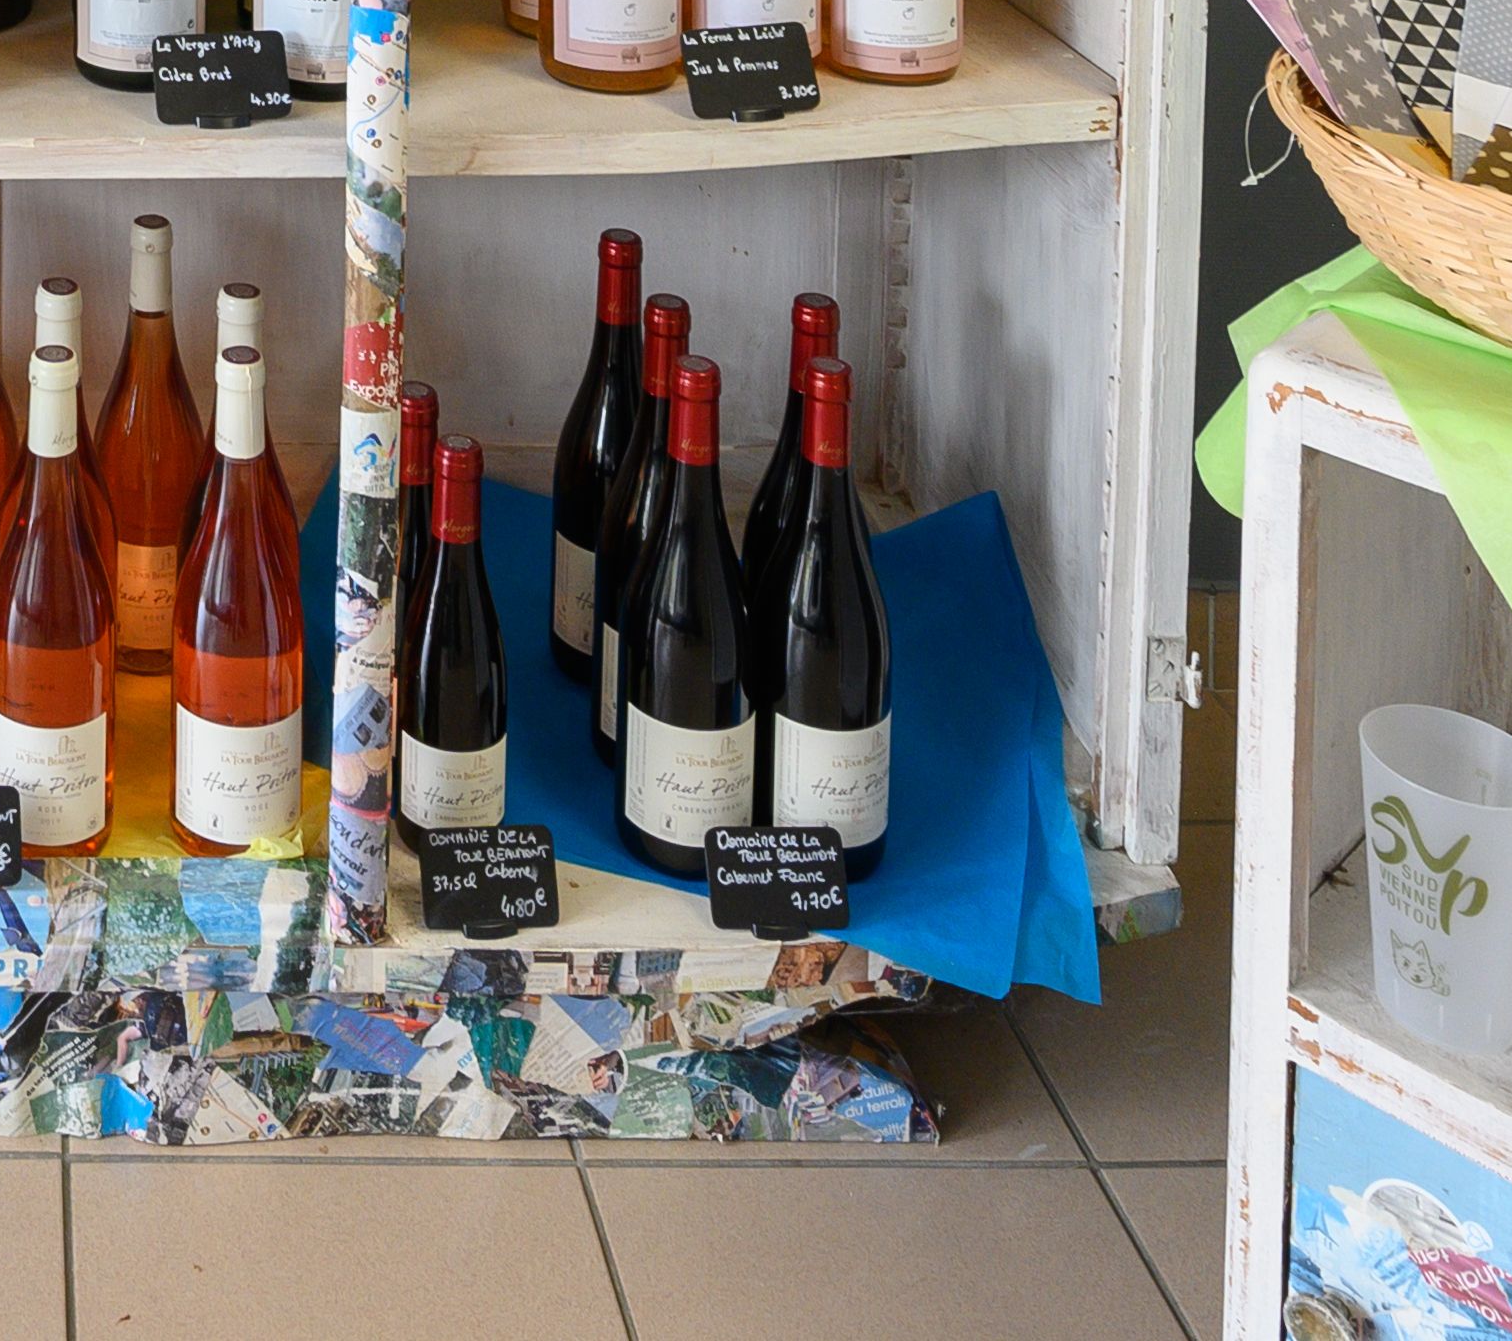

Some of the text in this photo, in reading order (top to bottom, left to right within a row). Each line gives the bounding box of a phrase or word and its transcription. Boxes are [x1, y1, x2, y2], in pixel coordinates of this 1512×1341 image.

[159, 66, 232, 83] Cidre Brut
[687, 57, 779, 75] Jus de Pommes
[655, 771, 705, 798] Haut
[717, 832, 820, 850] Domaine de La
[717, 867, 826, 884] Cabernet Franc
[1402, 865, 1439, 893] SUD
[791, 886, 843, 912] 7,70€
[1380, 868, 1437, 913] VIENNE
[1379, 889, 1437, 931] POITOU
